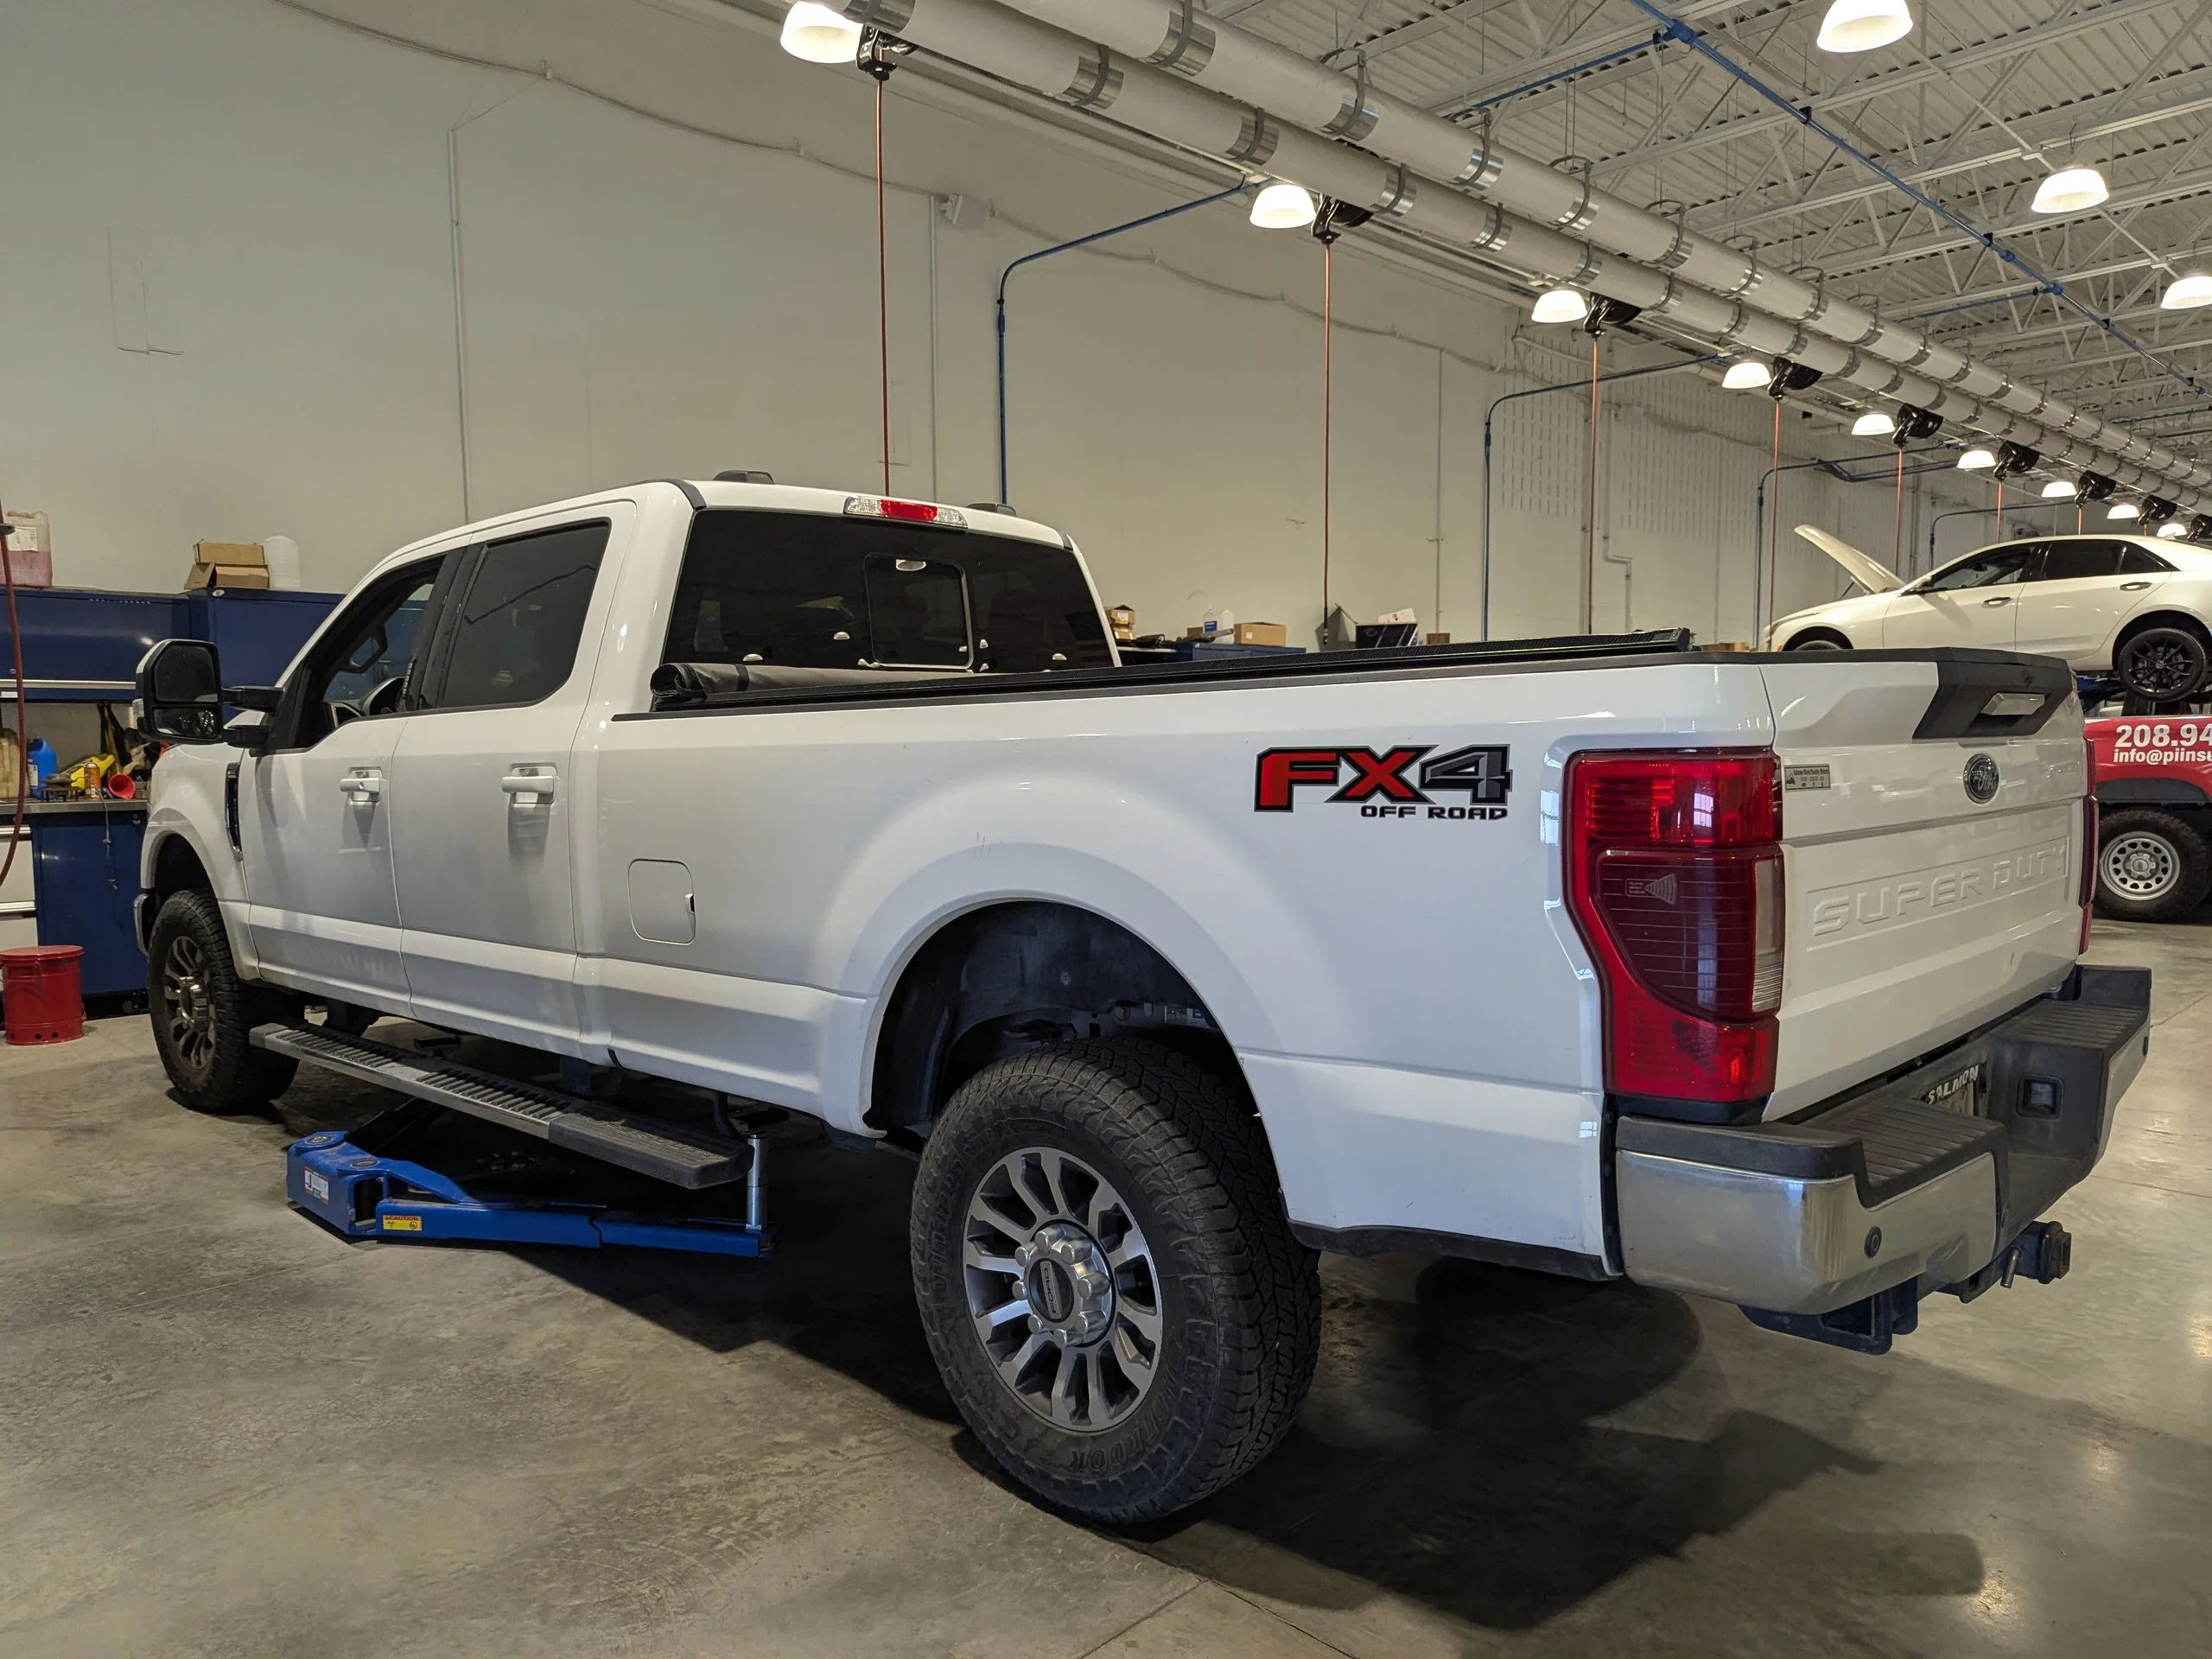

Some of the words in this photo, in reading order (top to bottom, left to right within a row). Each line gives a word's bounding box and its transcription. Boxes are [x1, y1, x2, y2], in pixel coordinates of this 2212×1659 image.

[1254, 744, 1513, 812] FX4
[1360, 805, 1416, 819] OFF
[1427, 806, 1508, 820] ROAD
[1813, 868, 1985, 937] SUPER
[1928, 1065, 1980, 1105] SALMON
[1044, 1268, 1057, 1313] FORD
